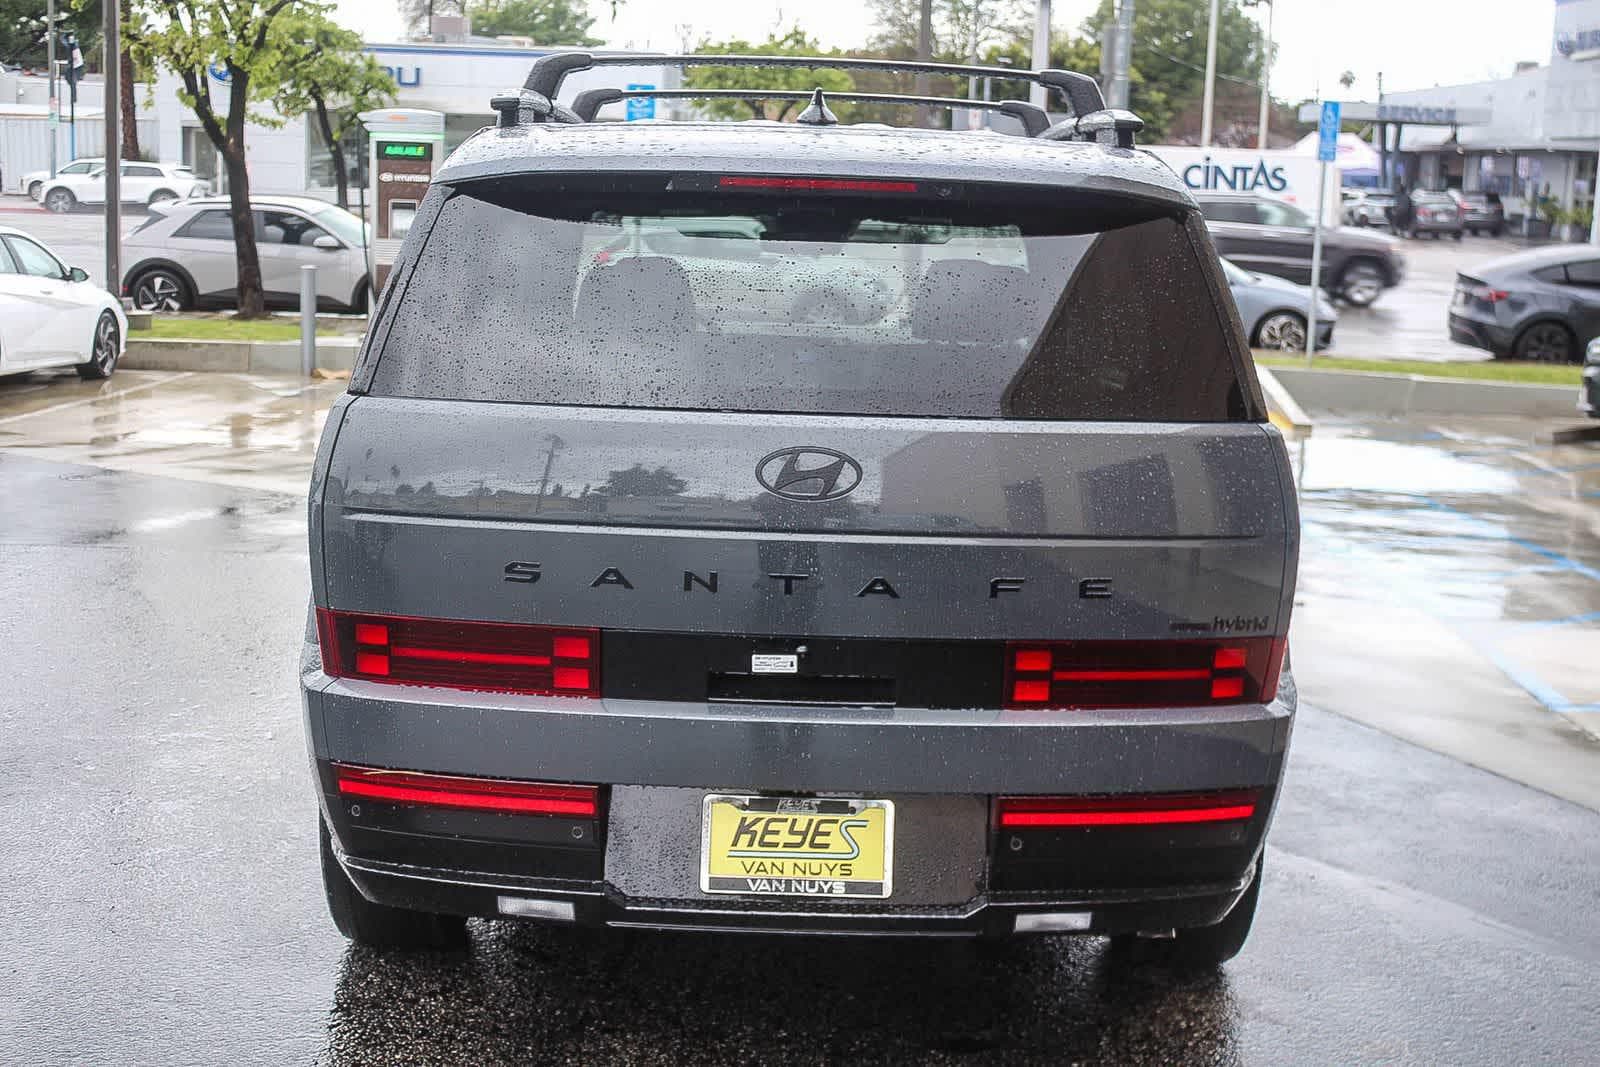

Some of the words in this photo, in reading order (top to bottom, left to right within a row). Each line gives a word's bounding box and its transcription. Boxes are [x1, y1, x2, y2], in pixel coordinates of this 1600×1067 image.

[504, 560, 899, 598] SANTA
[989, 576, 1112, 599] FE
[1213, 616, 1269, 632] hybrid
[728, 816, 869, 860] KEYES
[741, 861, 784, 875] VAN
[793, 862, 852, 876] NUYS
[746, 878, 785, 892] VAN
[792, 880, 846, 894] NUYS
